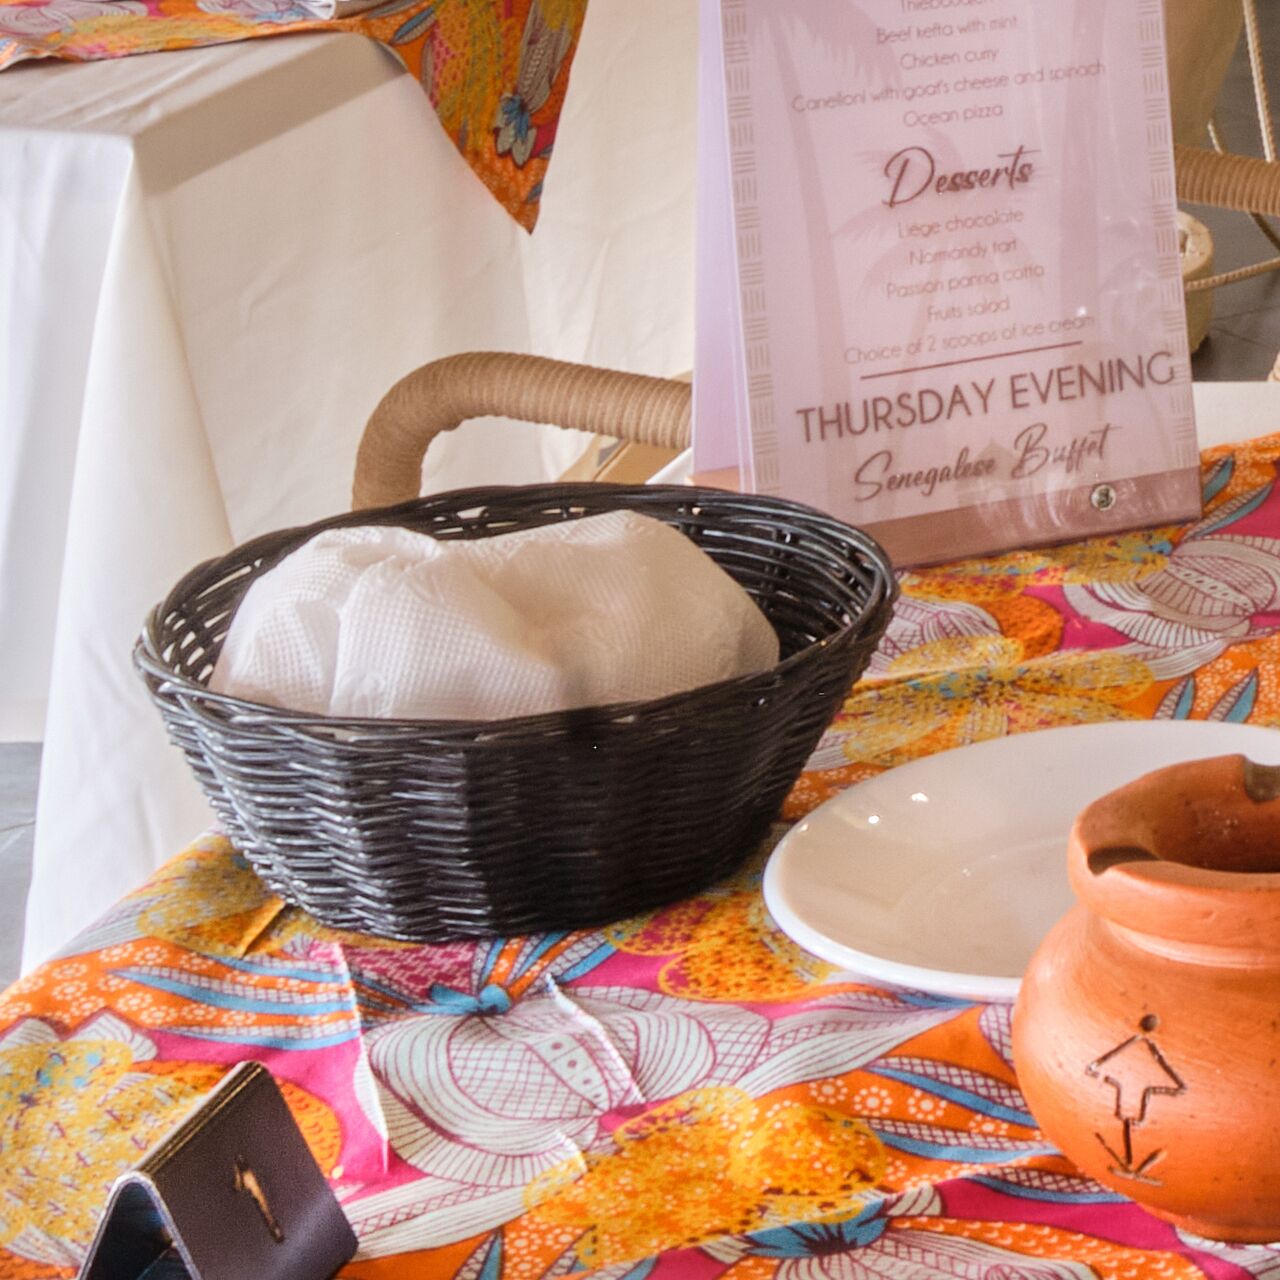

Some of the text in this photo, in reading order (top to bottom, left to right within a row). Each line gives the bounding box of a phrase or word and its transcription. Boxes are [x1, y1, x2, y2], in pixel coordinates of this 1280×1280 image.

[876, 26, 912, 45] Beef
[900, 48, 1000, 70] Chicken curry
[871, 86, 899, 102] with
[953, 74, 1009, 93] cheese
[1014, 67, 1045, 85] and
[1049, 59, 1105, 81] spinach
[903, 102, 1004, 128] Ocean pizza
[881, 144, 1041, 208] Desserts
[945, 209, 1024, 232] chocolate
[909, 242, 987, 266] Normandy
[948, 271, 999, 290] panna
[1003, 263, 1045, 282] cotta
[967, 296, 1010, 316] salad
[844, 346, 901, 365] Choice
[928, 336, 937, 352] 2
[942, 329, 998, 351] scoops
[1002, 324, 1018, 341] of
[1021, 322, 1045, 337] ice
[1048, 315, 1096, 333] cream
[796, 351, 1175, 444] THURSDAY EVENING
[854, 422, 1123, 502] Senegalese Buffet
